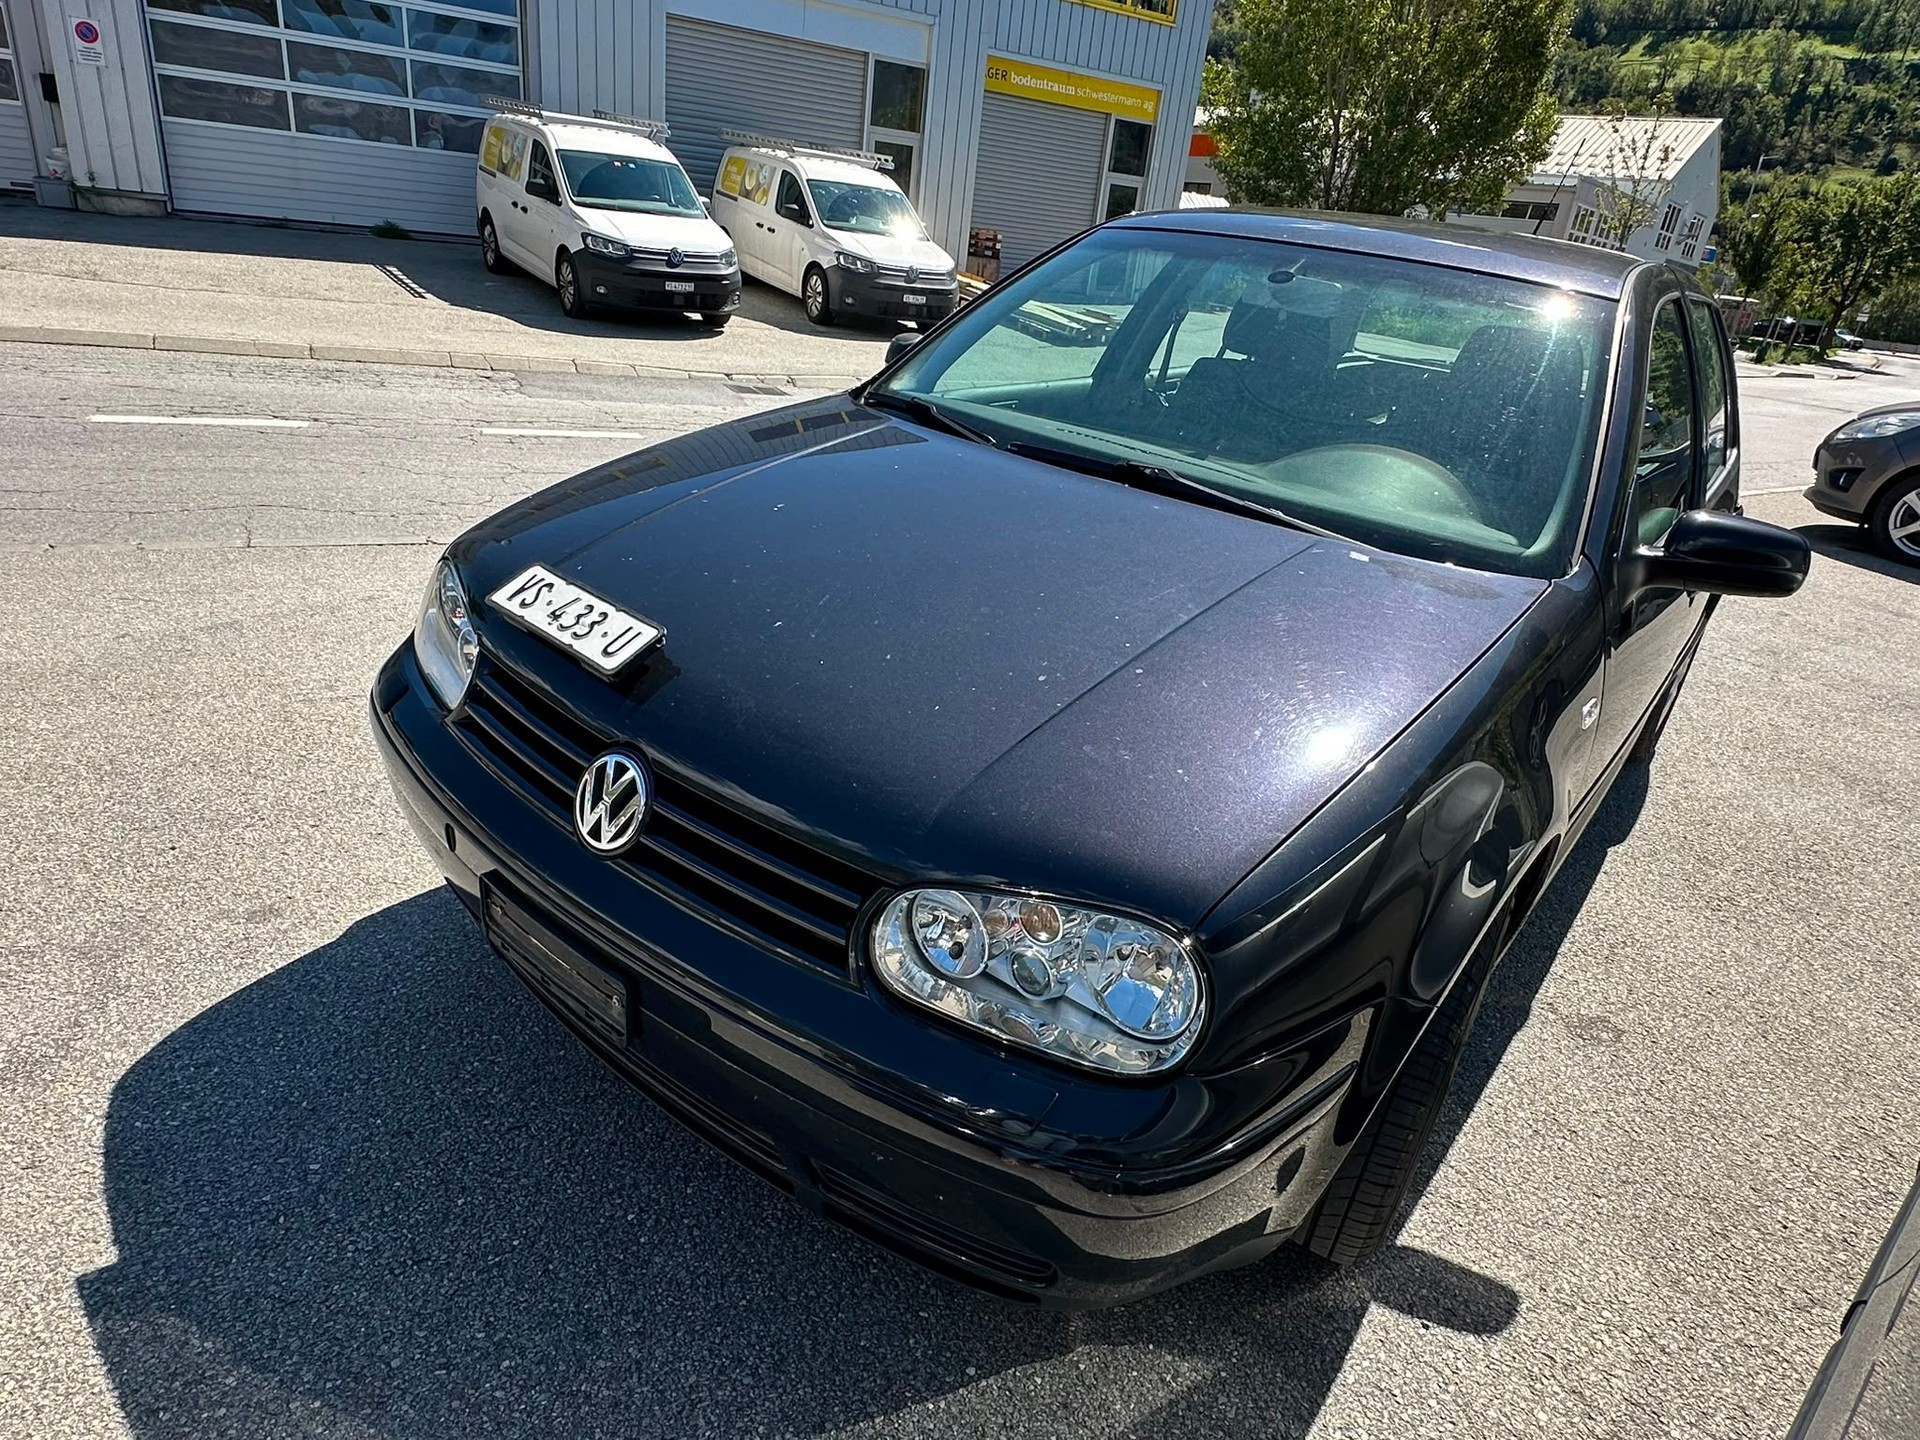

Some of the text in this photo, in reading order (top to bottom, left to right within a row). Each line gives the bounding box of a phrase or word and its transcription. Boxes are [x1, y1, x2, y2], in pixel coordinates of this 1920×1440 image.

[985, 67, 1008, 81] GER
[1011, 73, 1075, 95] bodentraum
[1077, 87, 1141, 108] schwestermann
